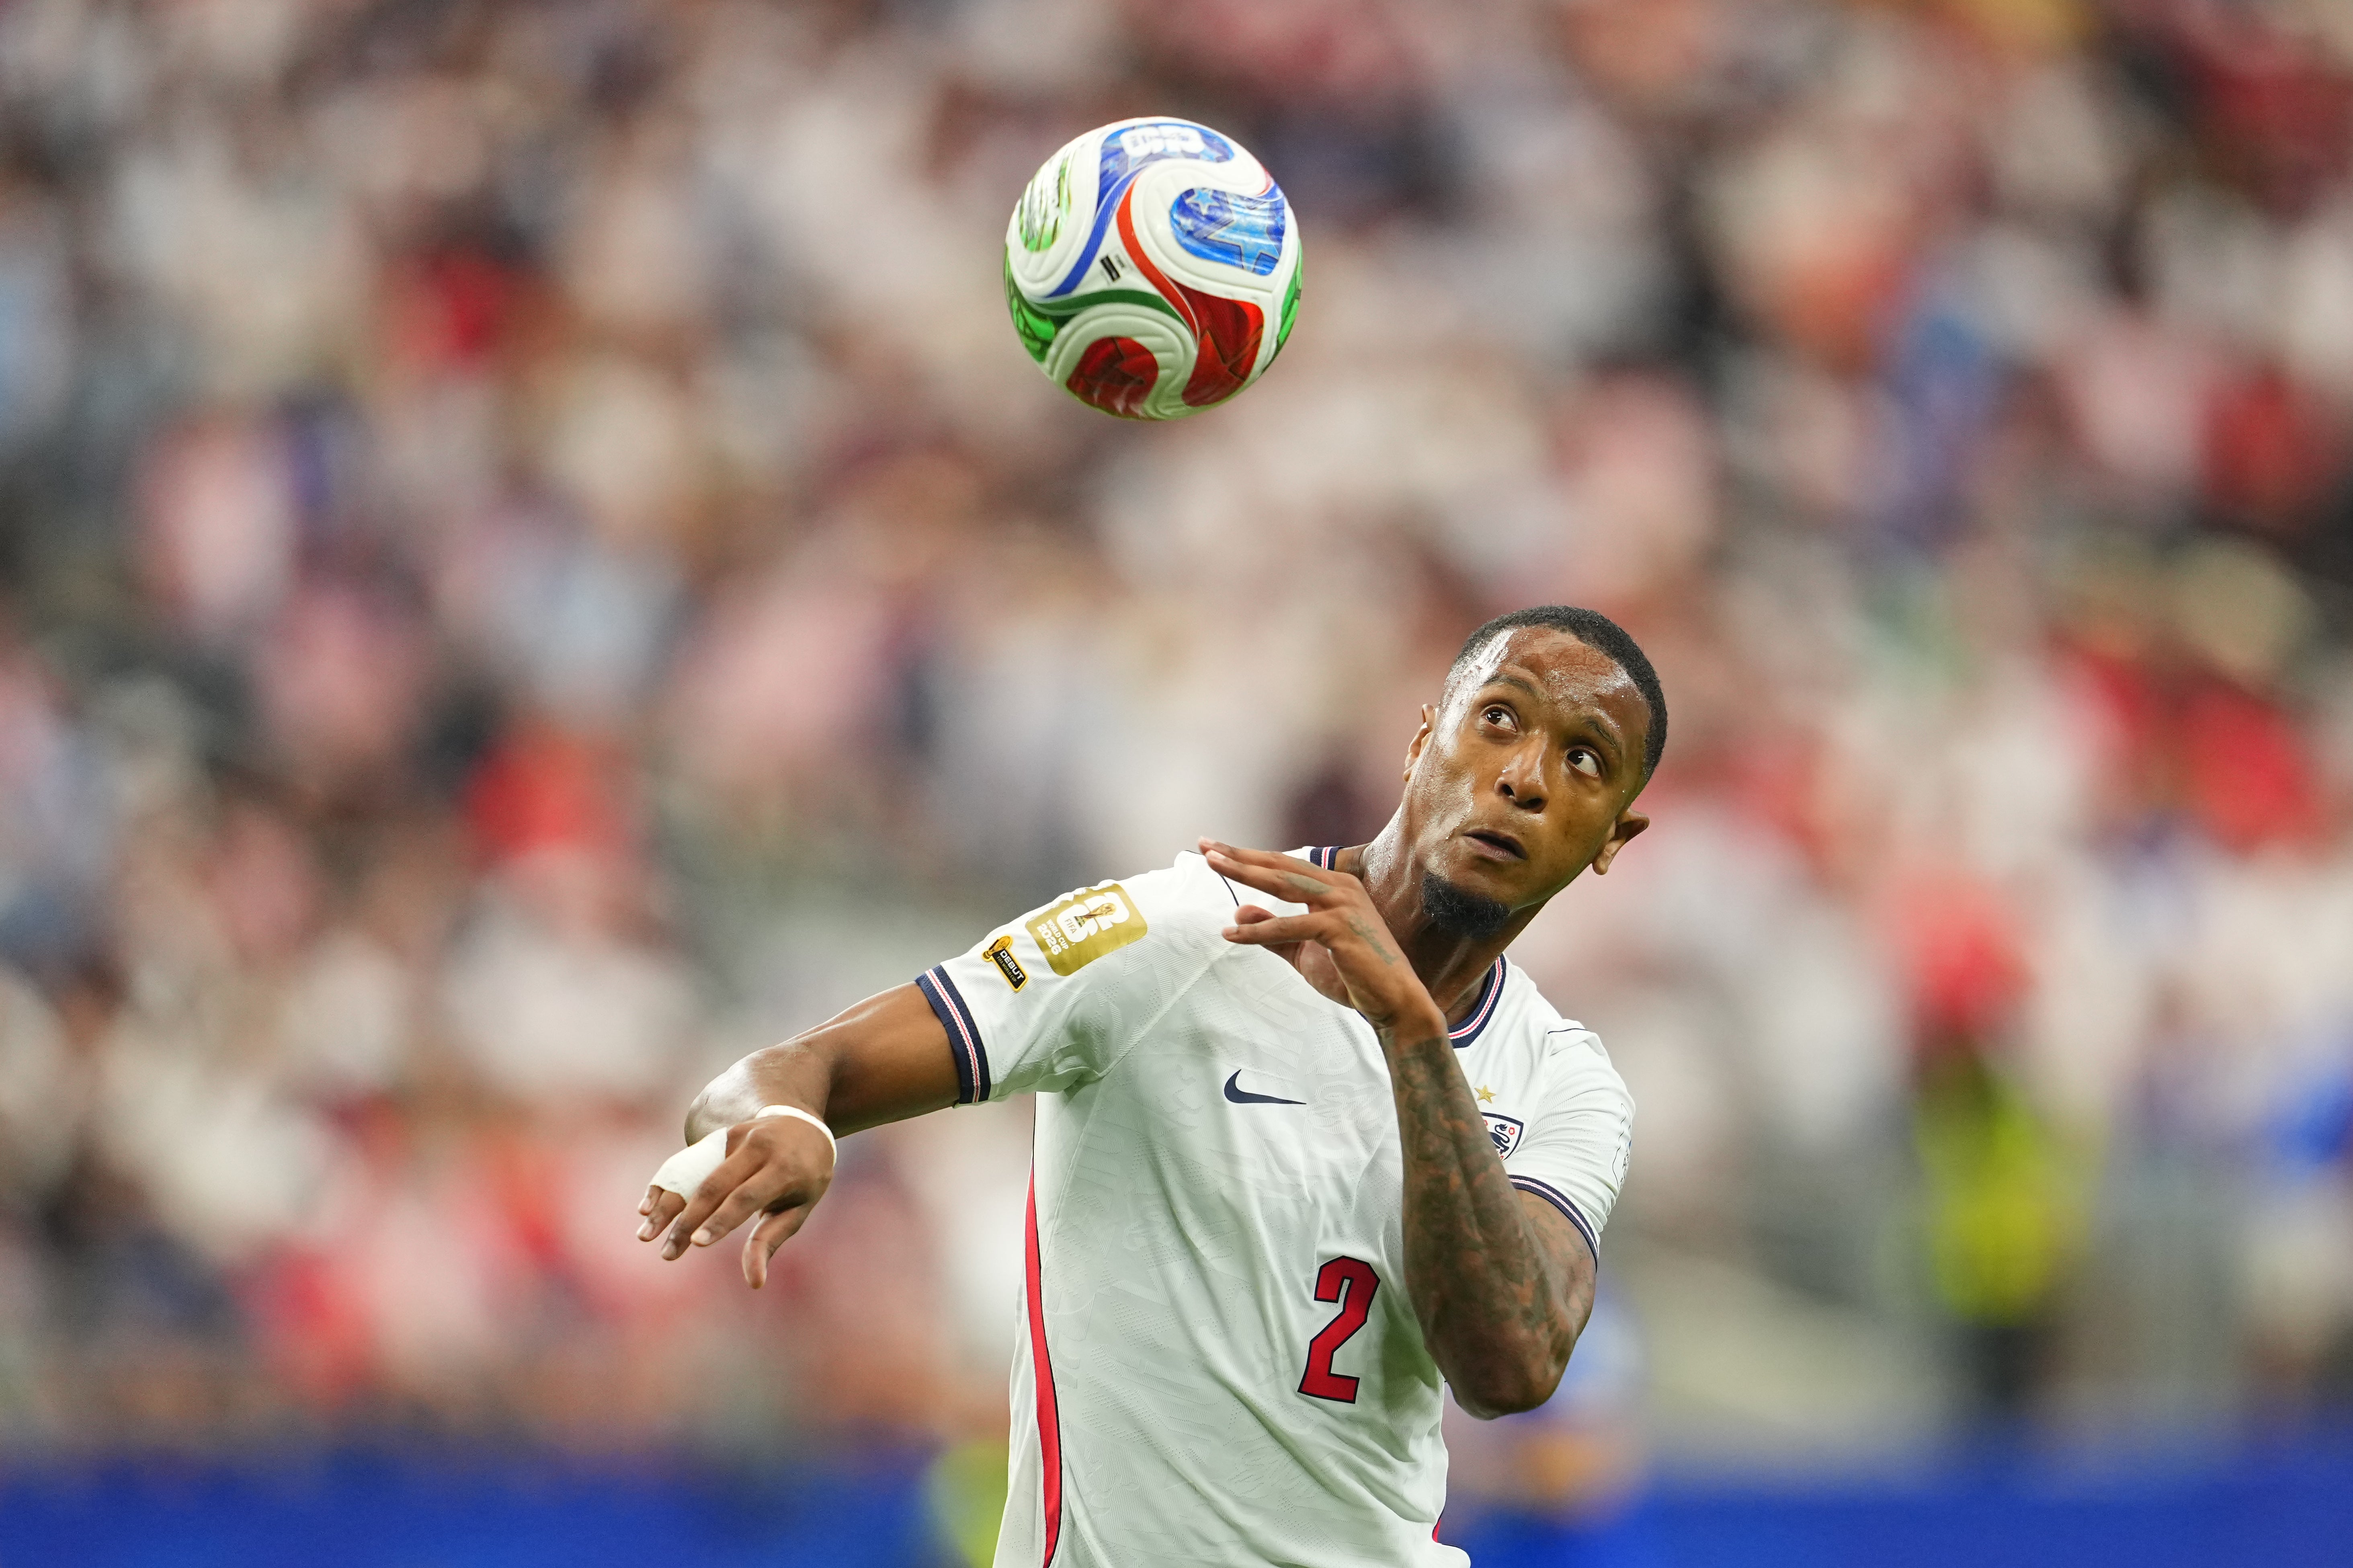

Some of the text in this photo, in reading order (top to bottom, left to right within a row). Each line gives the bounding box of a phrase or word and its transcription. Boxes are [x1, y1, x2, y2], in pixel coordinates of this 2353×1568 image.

[1037, 923, 1062, 955] 2026
[1046, 919, 1069, 950] WORLD CUP
[1064, 918, 1077, 934] FIFA
[1000, 950, 1025, 979] DEBUT
[1002, 962, 1012, 976] WORLD
[1297, 1255, 1380, 1404] 2
